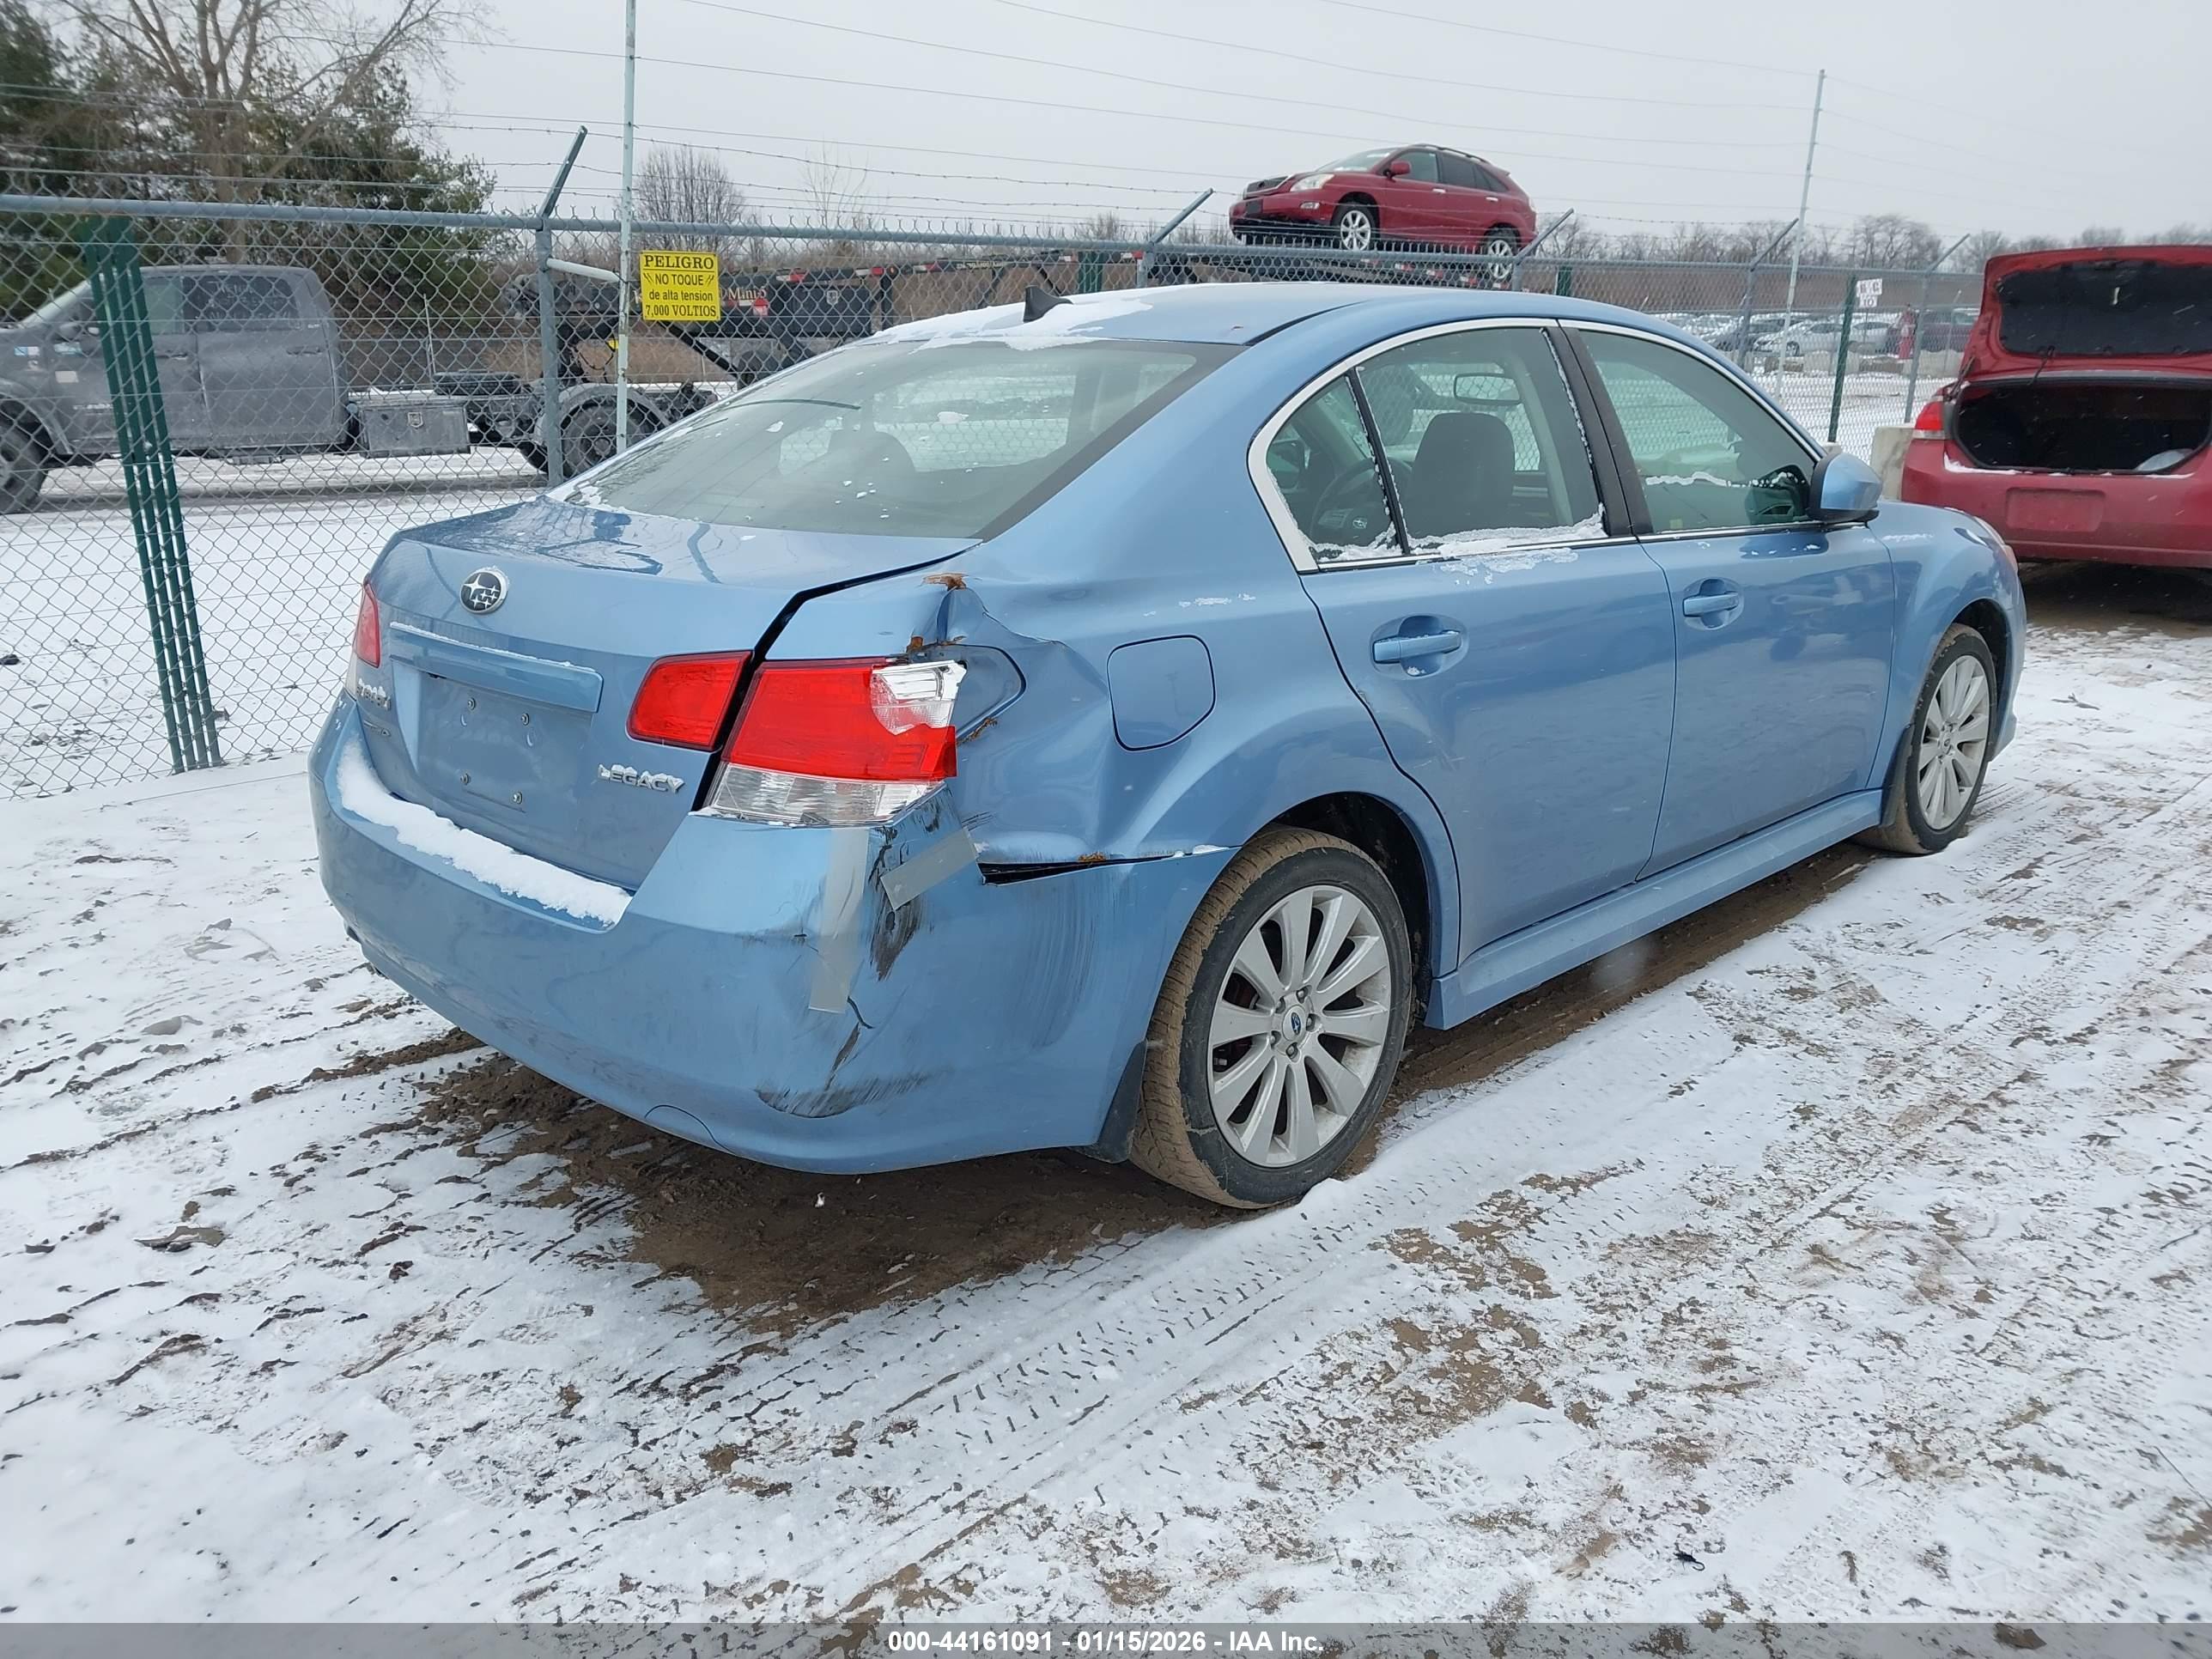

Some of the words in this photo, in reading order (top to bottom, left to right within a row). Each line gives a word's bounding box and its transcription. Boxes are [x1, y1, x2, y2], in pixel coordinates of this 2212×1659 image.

[644, 255, 714, 270] PELIGRO
[655, 274, 669, 285] NO
[672, 274, 704, 286] TOQUE
[649, 289, 660, 301] de
[663, 289, 678, 301] alta
[681, 290, 714, 301] tension
[646, 305, 670, 317] 7,000
[672, 305, 716, 317] VOLTIOS
[598, 765, 684, 793] LEGACY
